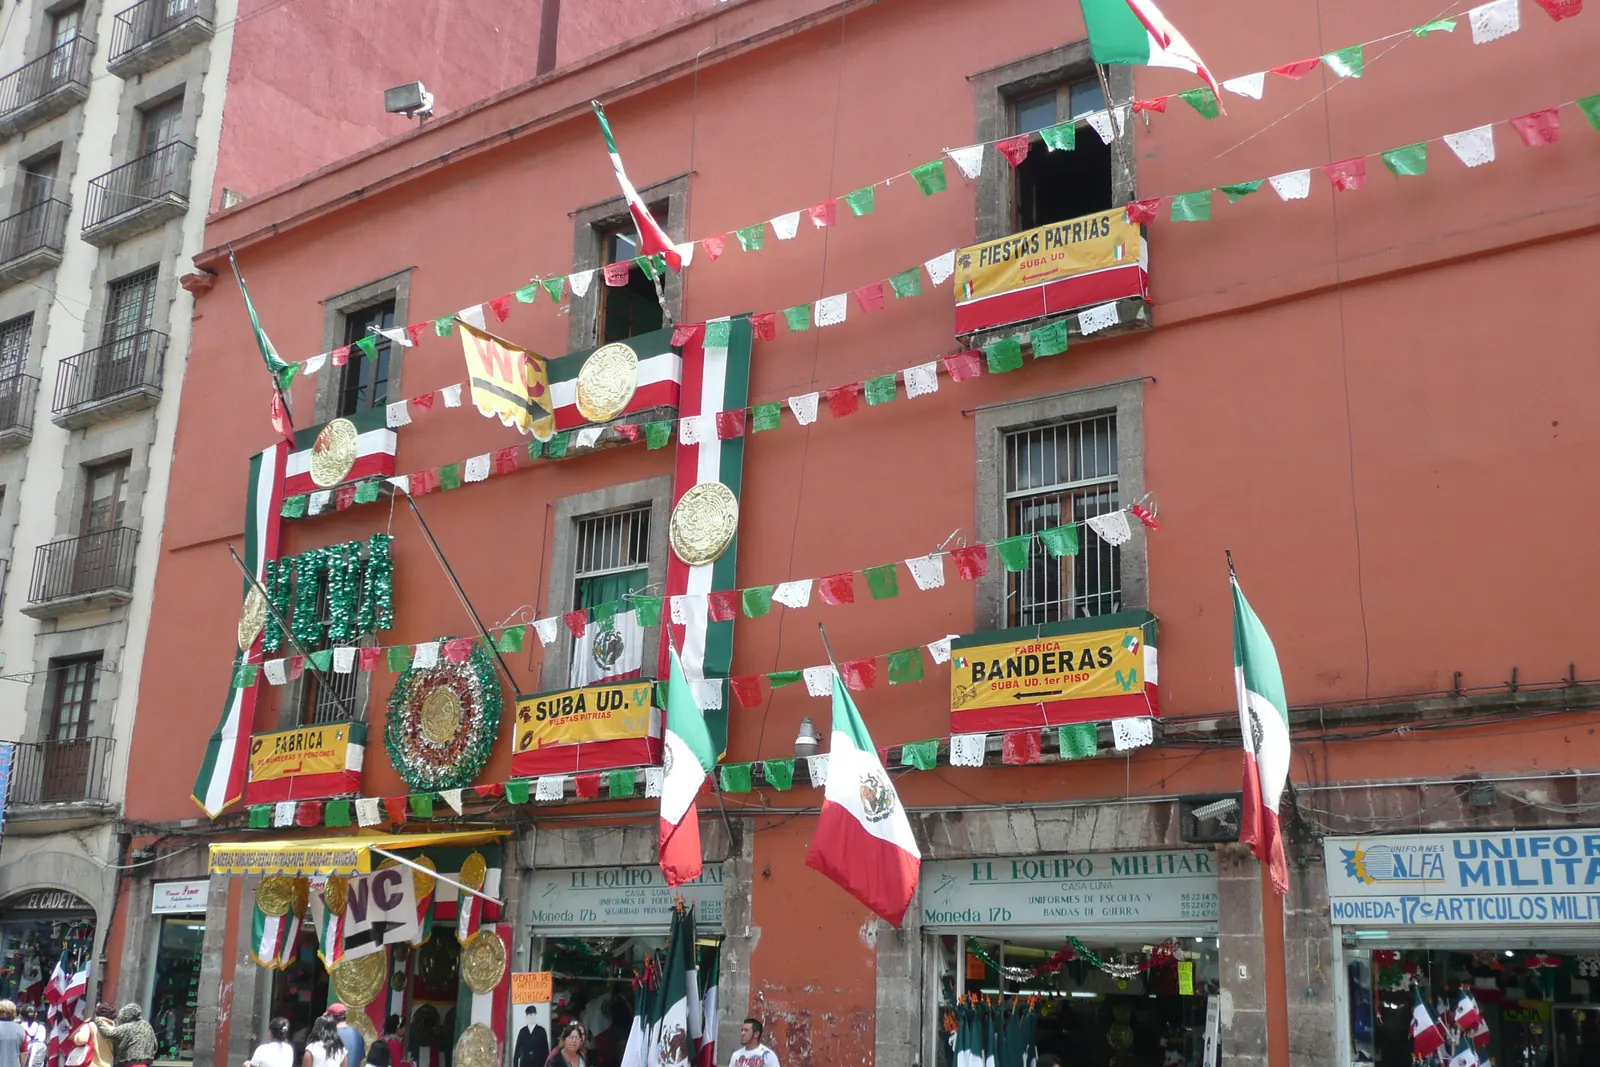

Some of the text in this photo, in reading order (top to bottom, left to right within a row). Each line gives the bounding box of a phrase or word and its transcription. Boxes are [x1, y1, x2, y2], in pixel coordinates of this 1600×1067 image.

[979, 216, 1110, 268] FIESTAS PATRIAS
[1020, 252, 1065, 270] SUBA UD
[471, 335, 546, 399] WC
[1014, 642, 1061, 655] FABRICA
[971, 645, 1113, 683] BANDERAS
[991, 672, 1090, 691] SUBA UD. 1er PISO
[535, 690, 629, 721] SUBA UD.
[549, 714, 579, 726] FIESTAS
[275, 731, 323, 755] FABRICA
[1390, 845, 1445, 853] UNIFORMES
[972, 853, 1212, 881] EL EQUIPO MILITAR
[1392, 853, 1445, 878] ALFA
[571, 871, 590, 888] EL
[596, 868, 652, 889] EQUIPO
[1061, 881, 1113, 891] CASA LUNA
[28, 892, 77, 909] EL CADETE
[625, 889, 671, 898] CASA LUNA
[1028, 893, 1153, 905] UNIFORMES DE ESCOLTA Y
[531, 908, 597, 922] Moneda 17b
[924, 907, 1012, 923] Moneda 17b
[1043, 907, 1139, 917] BANDAS DE GUERRA
[1434, 896, 1548, 921] ARTICULOS
